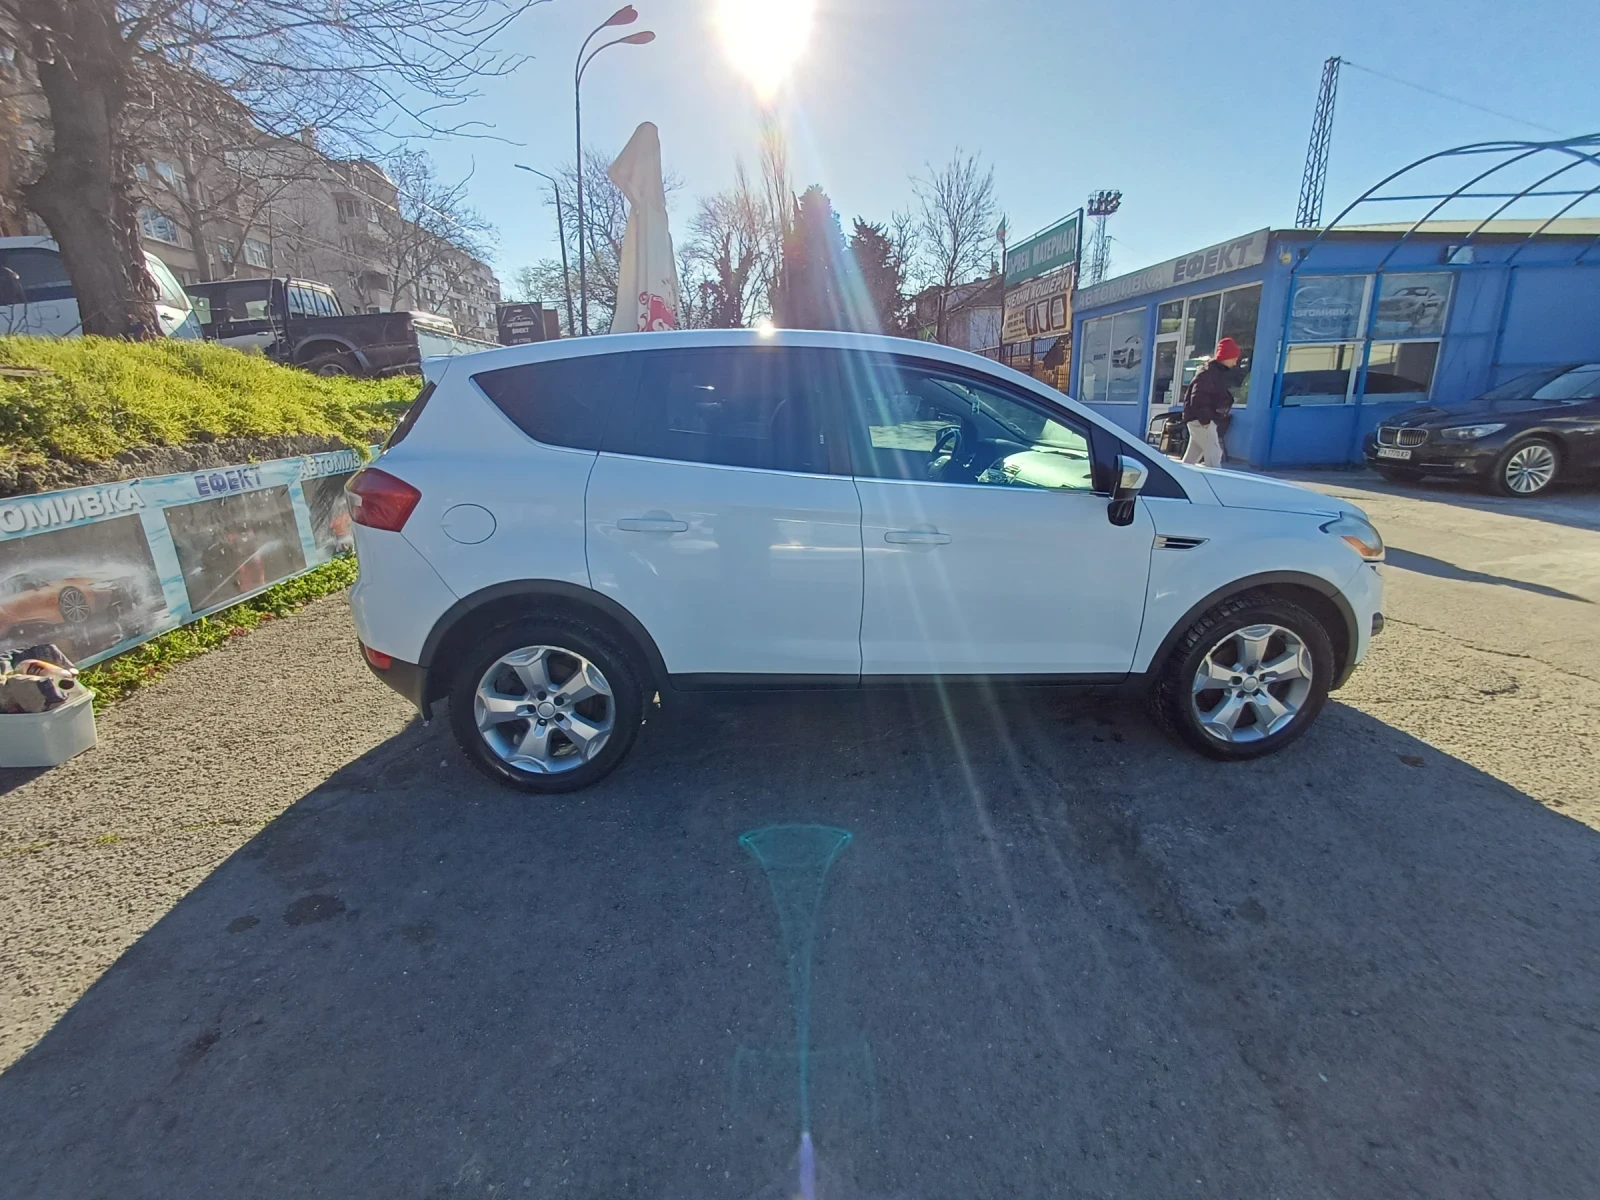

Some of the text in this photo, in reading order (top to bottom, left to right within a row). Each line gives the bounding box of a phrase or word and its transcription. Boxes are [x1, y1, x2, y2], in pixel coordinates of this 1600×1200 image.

[1033, 227, 1075, 267] МАТЕРИАЛ
[1078, 238, 1254, 306] АВТОМИВКА ЕФЕКТ
[0, 452, 364, 533] ОМИВКА ЕФЕКТ АВТОМИВ
